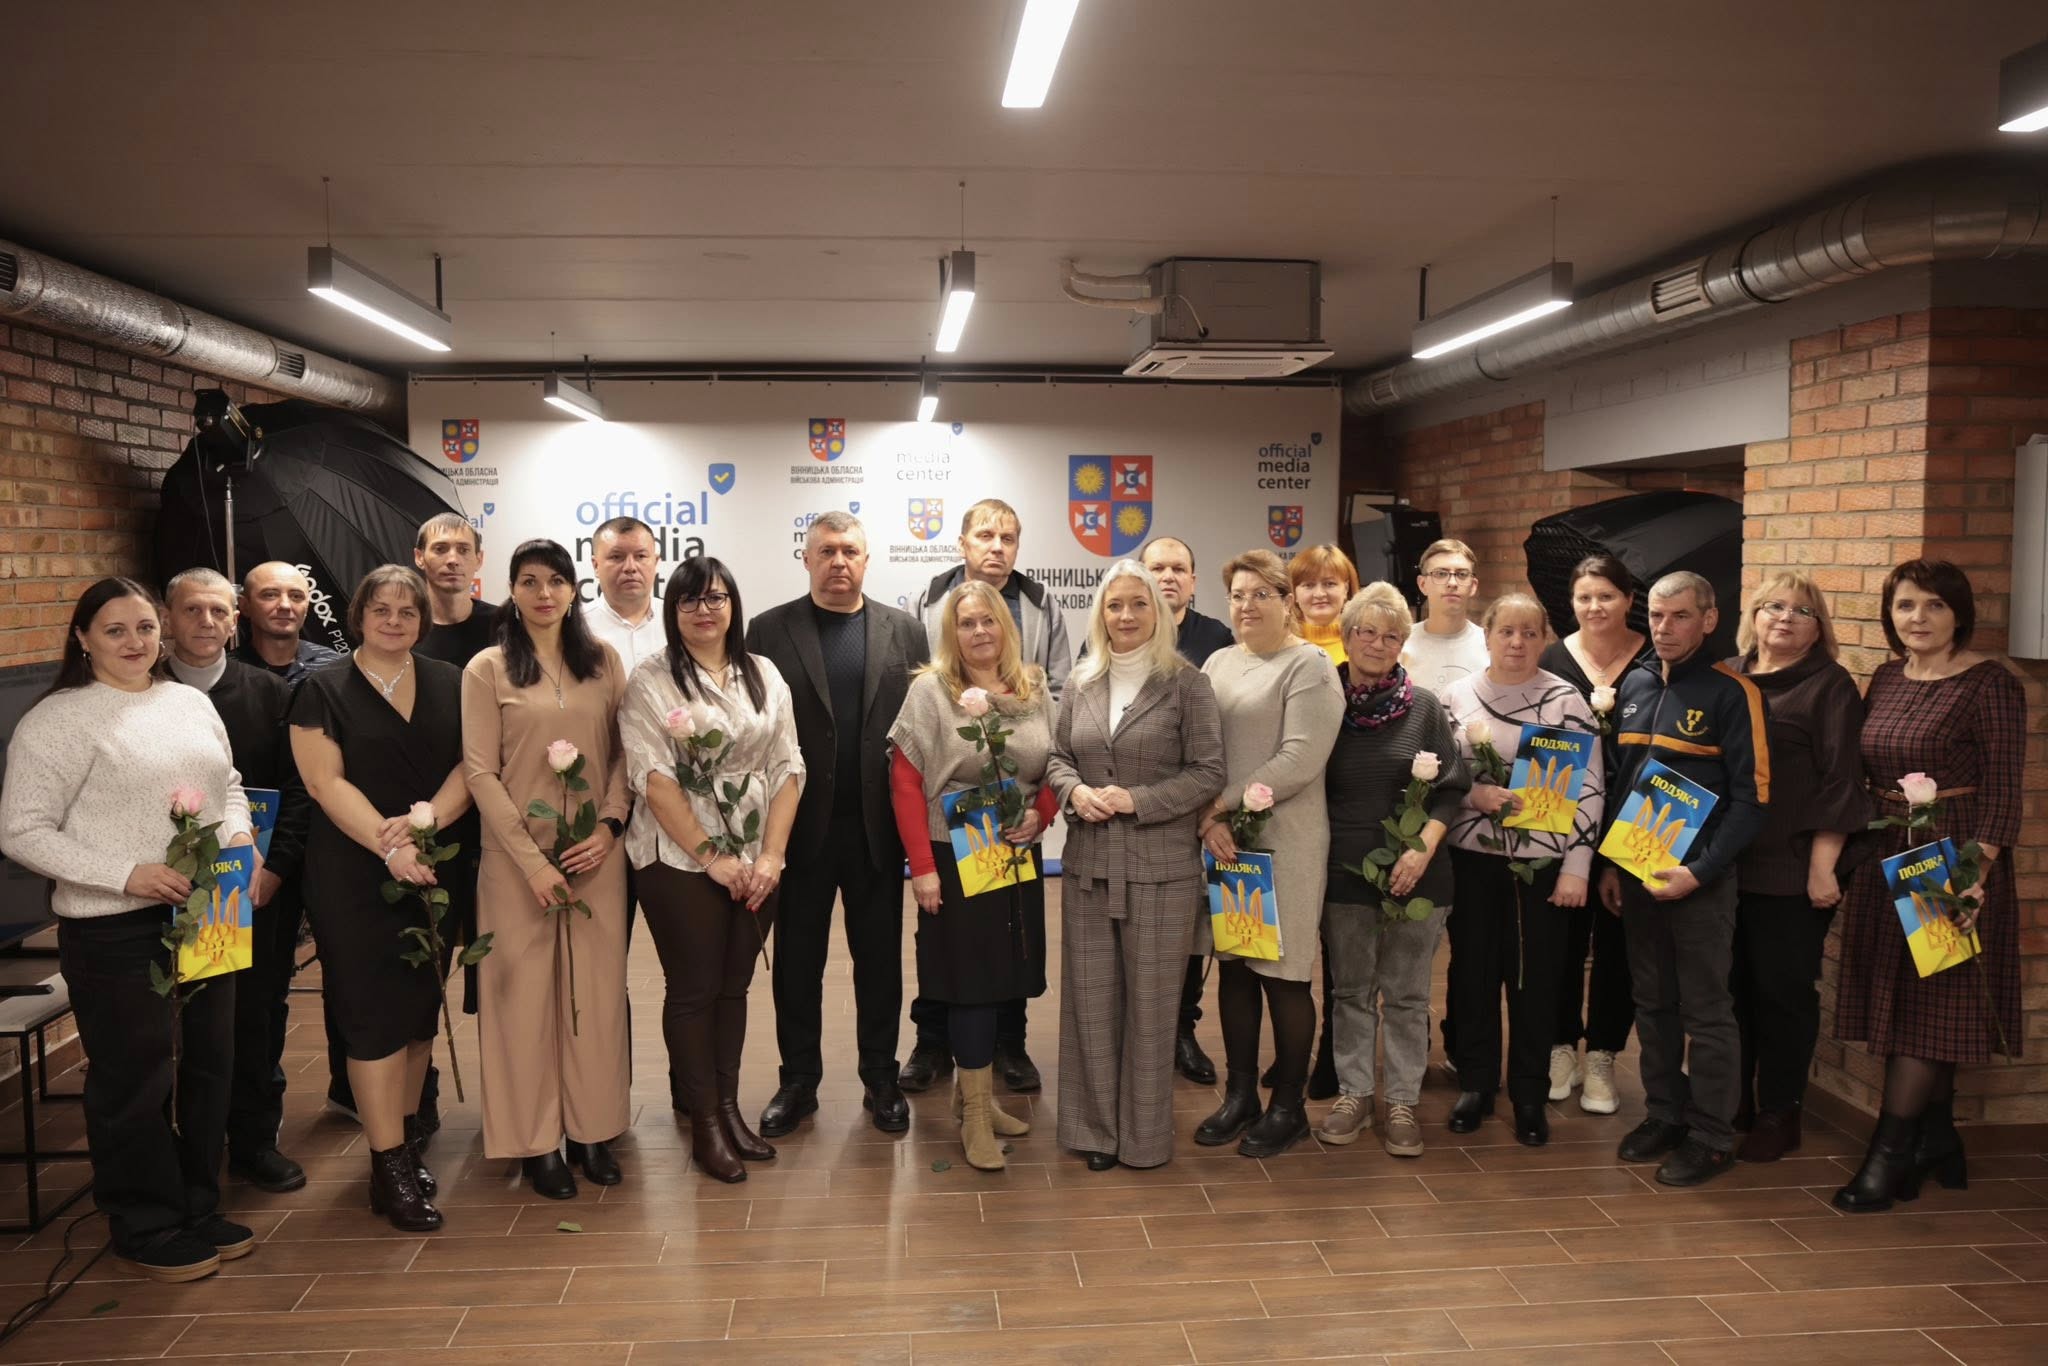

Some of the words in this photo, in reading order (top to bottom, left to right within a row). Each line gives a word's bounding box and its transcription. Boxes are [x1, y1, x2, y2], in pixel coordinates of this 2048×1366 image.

[1258, 443, 1312, 458] official
[464, 467, 498, 476] ОБЛАСНА
[790, 465, 830, 475] ВІННИЦЬКА
[830, 465, 863, 475] ОБЛАСНА
[1258, 458, 1310, 472] media
[896, 468, 952, 481] center
[1258, 476, 1311, 489] center
[576, 491, 708, 525] official
[327, 629, 352, 656] P120
[1530, 736, 1580, 753] ПОДЯКА
[1650, 774, 1700, 810] ПОДЯКА
